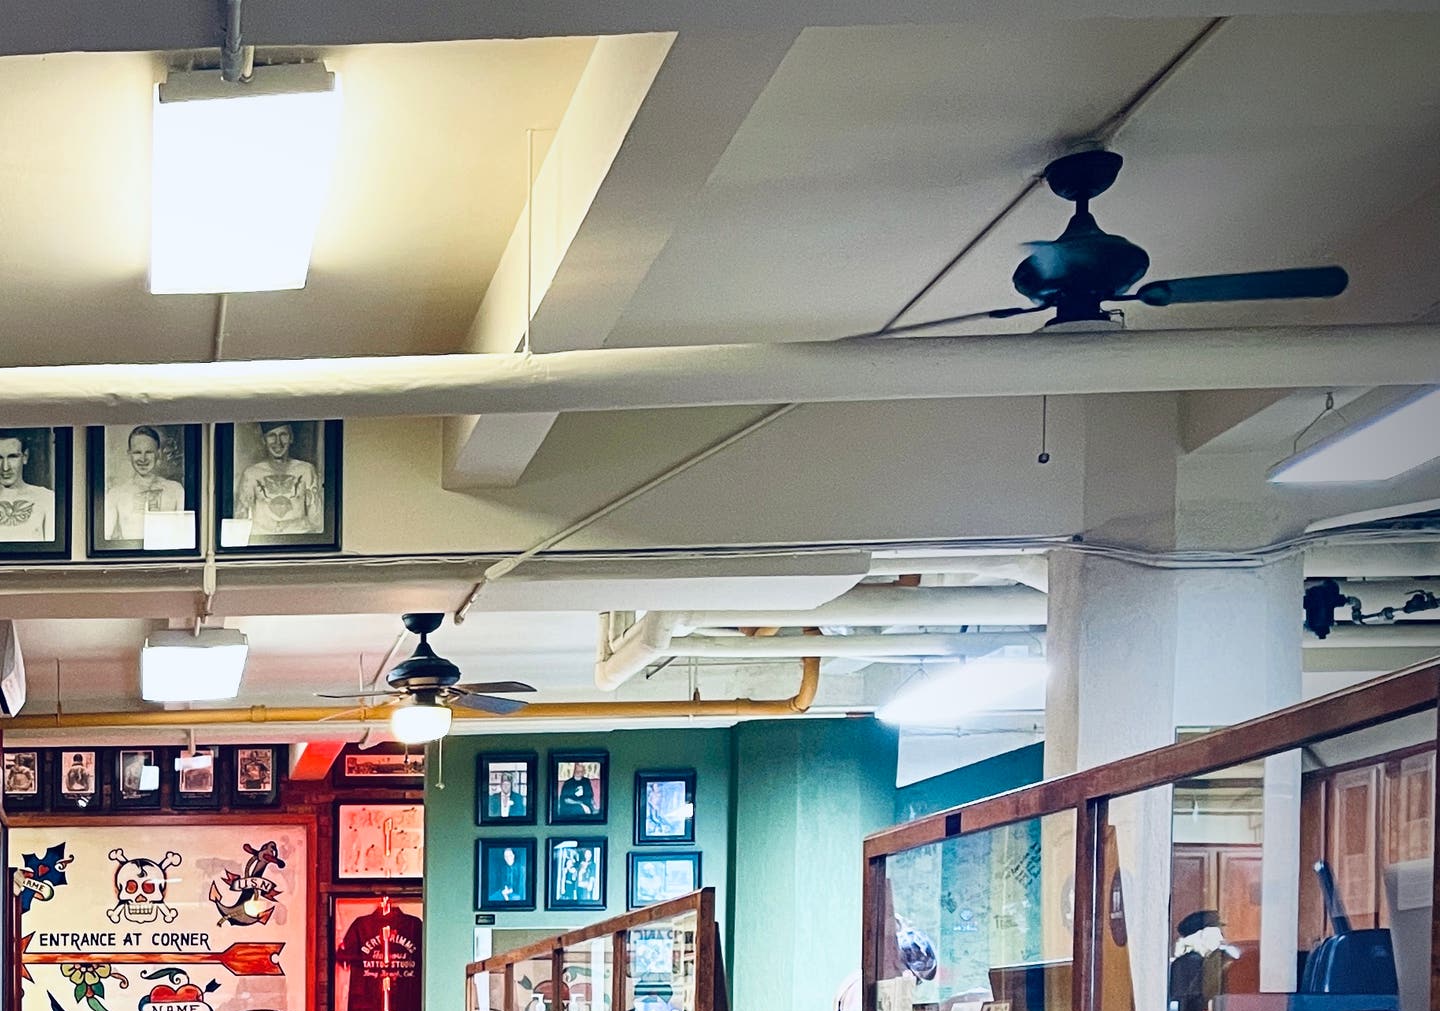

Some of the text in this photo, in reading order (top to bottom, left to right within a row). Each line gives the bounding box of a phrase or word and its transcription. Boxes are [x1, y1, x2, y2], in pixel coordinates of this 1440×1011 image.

[23, 879, 46, 892] AME
[39, 932, 211, 951] ENTRANCE AT CORNER
